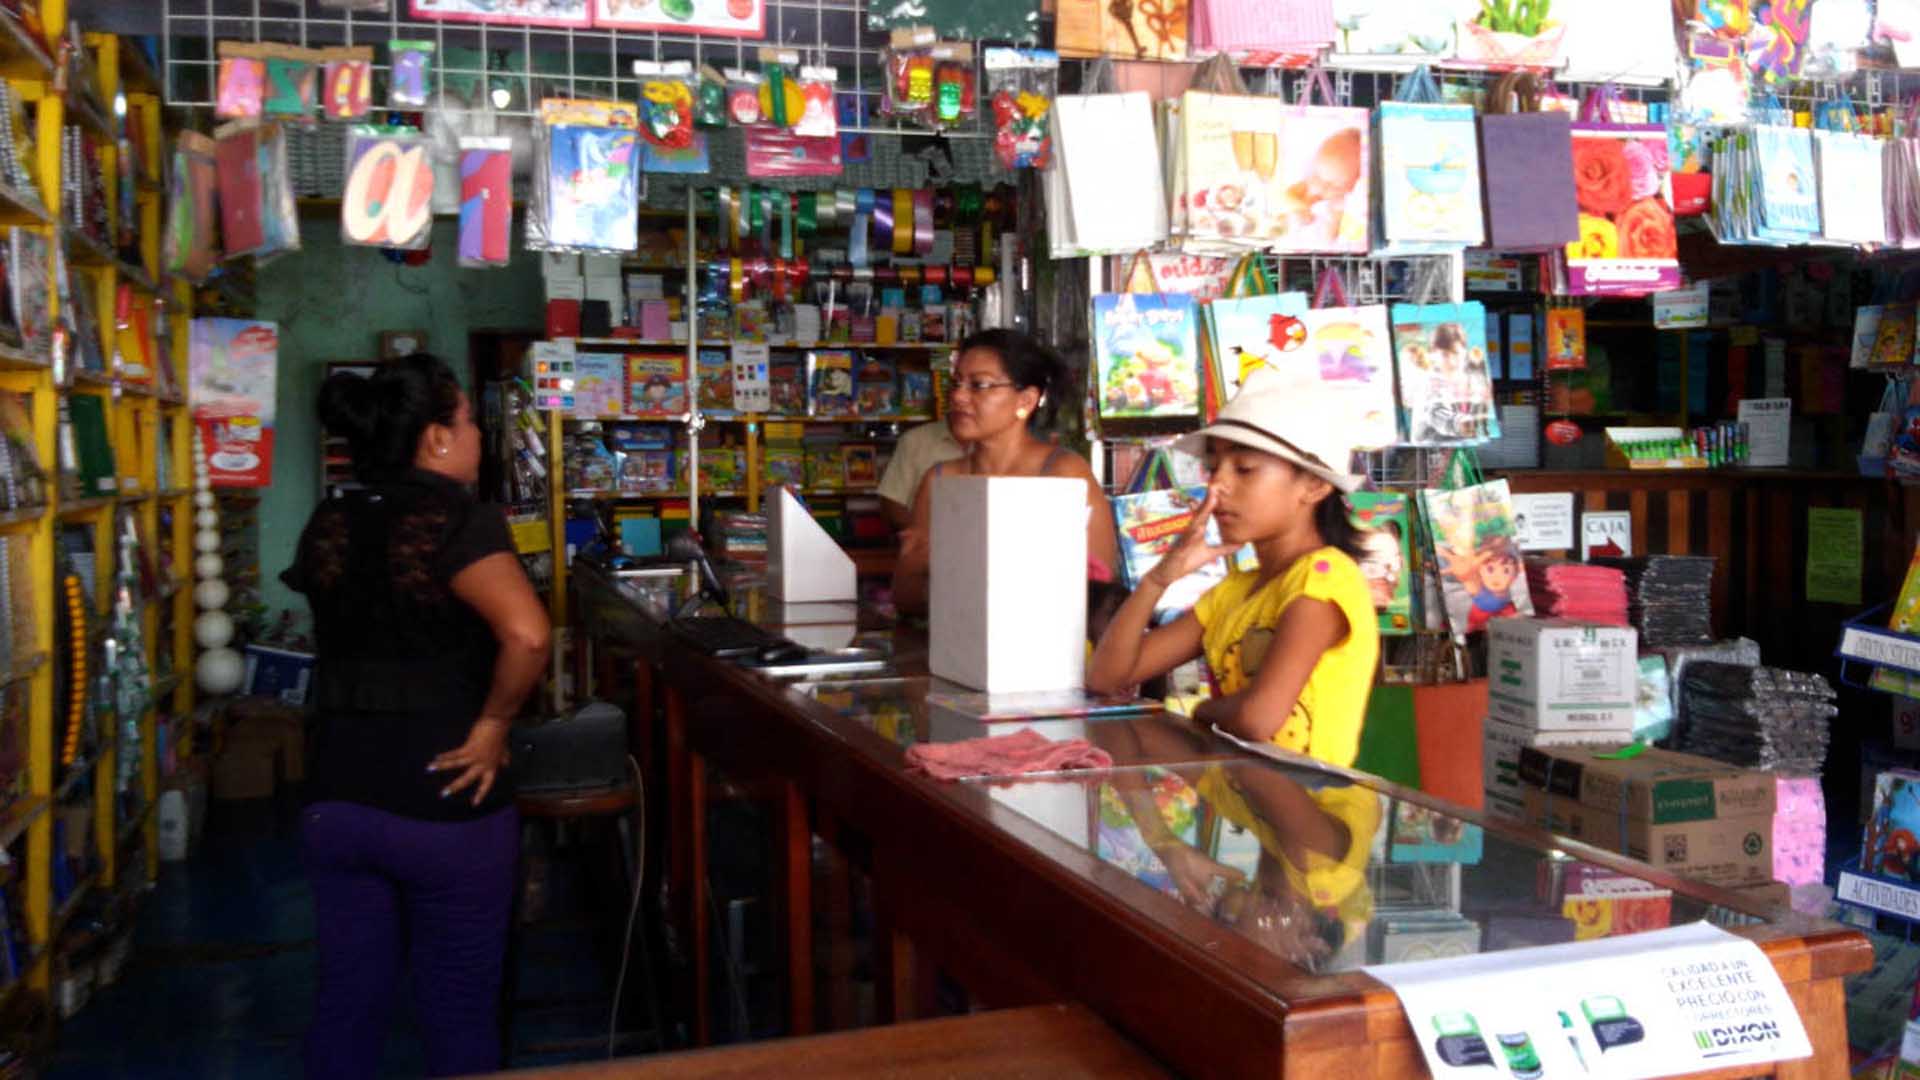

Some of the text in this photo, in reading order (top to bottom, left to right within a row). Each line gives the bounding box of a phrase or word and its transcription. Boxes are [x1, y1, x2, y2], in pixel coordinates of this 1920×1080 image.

[1586, 519, 1626, 536] CAJA
[1667, 970, 1757, 994] EXCELENTE
[1687, 1004, 1774, 1022] ORRECTORES
[1711, 1020, 1781, 1047] DIXON
